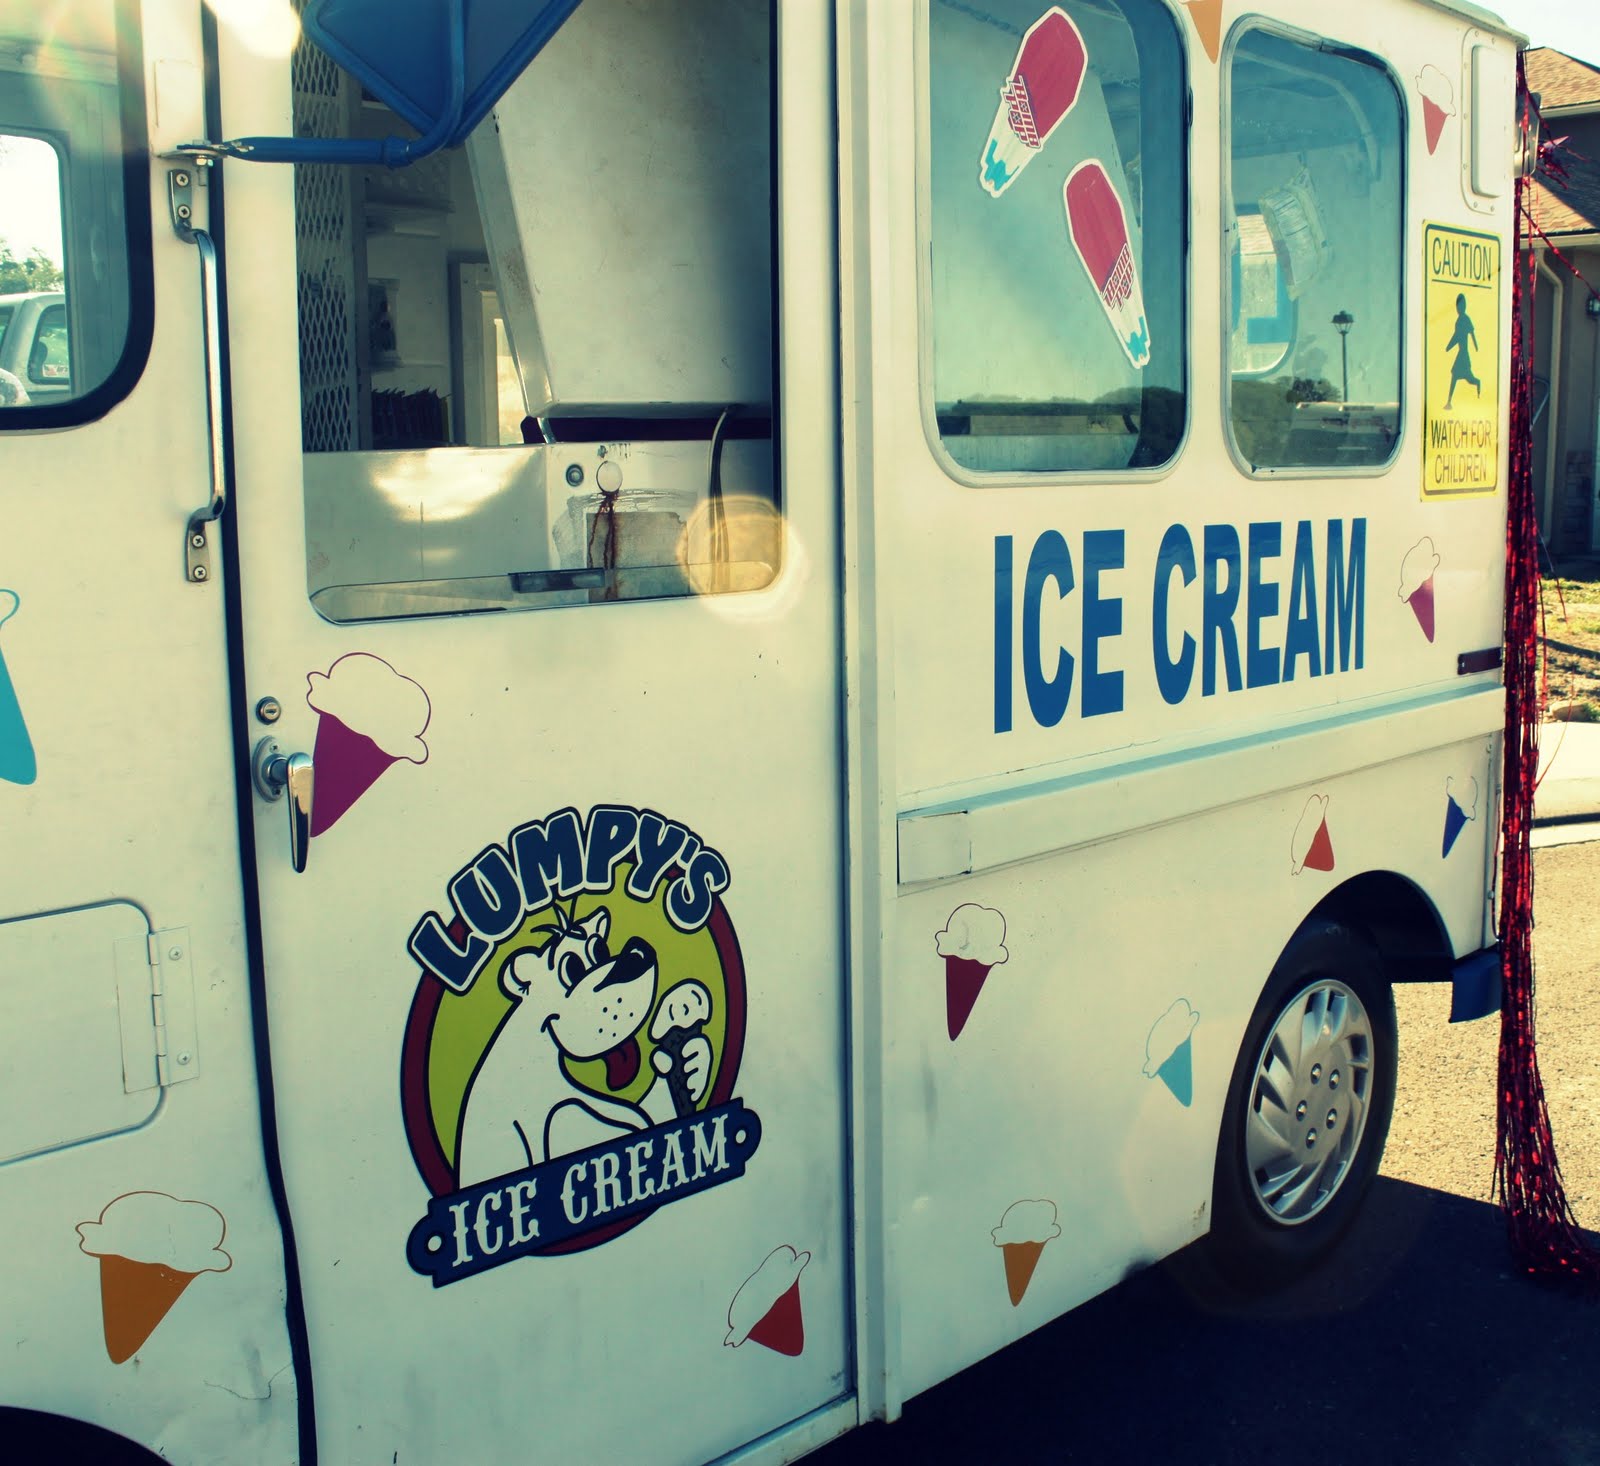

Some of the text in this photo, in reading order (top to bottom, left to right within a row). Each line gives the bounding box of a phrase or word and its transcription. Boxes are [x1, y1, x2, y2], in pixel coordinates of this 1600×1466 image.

[1432, 236, 1492, 282] CAUTION
[1431, 419, 1492, 449] WATCH FOR
[1434, 454, 1487, 484] CHILDREN
[994, 517, 1367, 734] ICE CREAM
[408, 804, 731, 994] LUMPY'S
[448, 1113, 731, 1268] ICE CREAM
